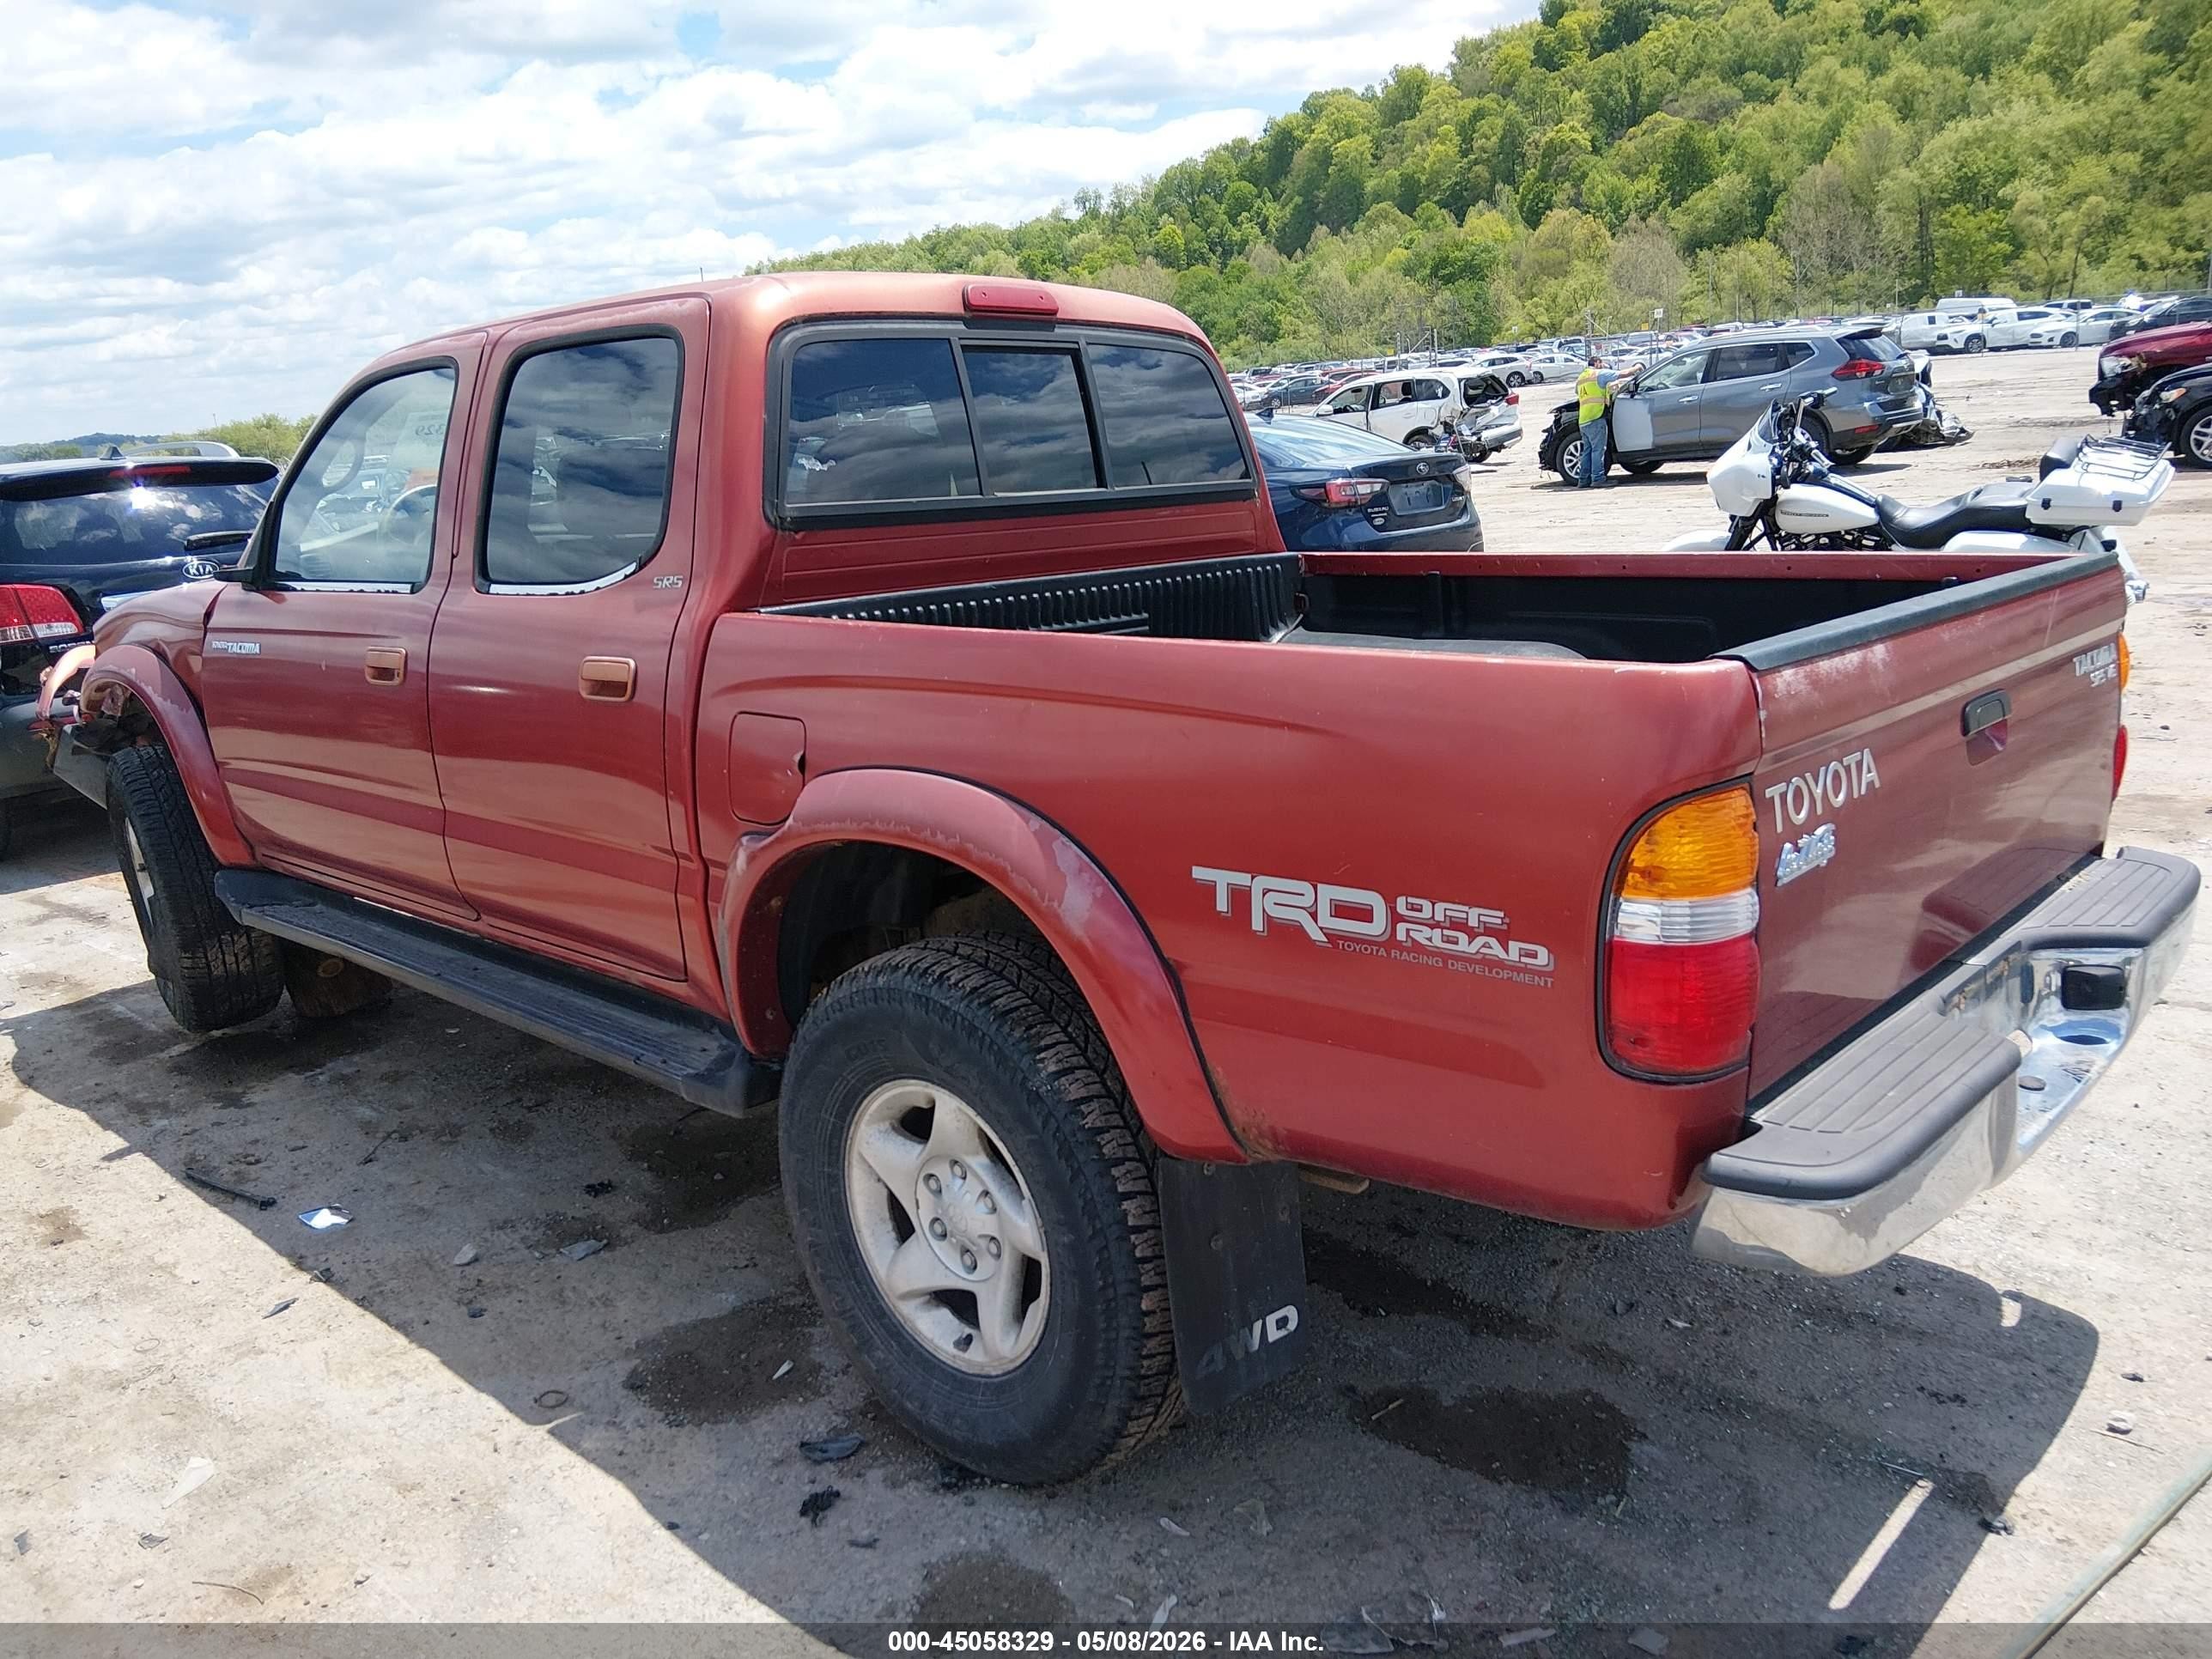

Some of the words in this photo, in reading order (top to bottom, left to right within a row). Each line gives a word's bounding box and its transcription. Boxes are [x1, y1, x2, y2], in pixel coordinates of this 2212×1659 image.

[188, 562, 214, 576] KIA
[1765, 748, 1881, 834] TOYOTA
[1191, 866, 1391, 948] TRD
[1395, 895, 1510, 930] OFF
[1337, 939, 1388, 958] TOYOTA
[1390, 949, 1444, 968] RACING
[1448, 958, 1555, 988] DEVELOPMENT
[1395, 922, 1554, 972] ROAD
